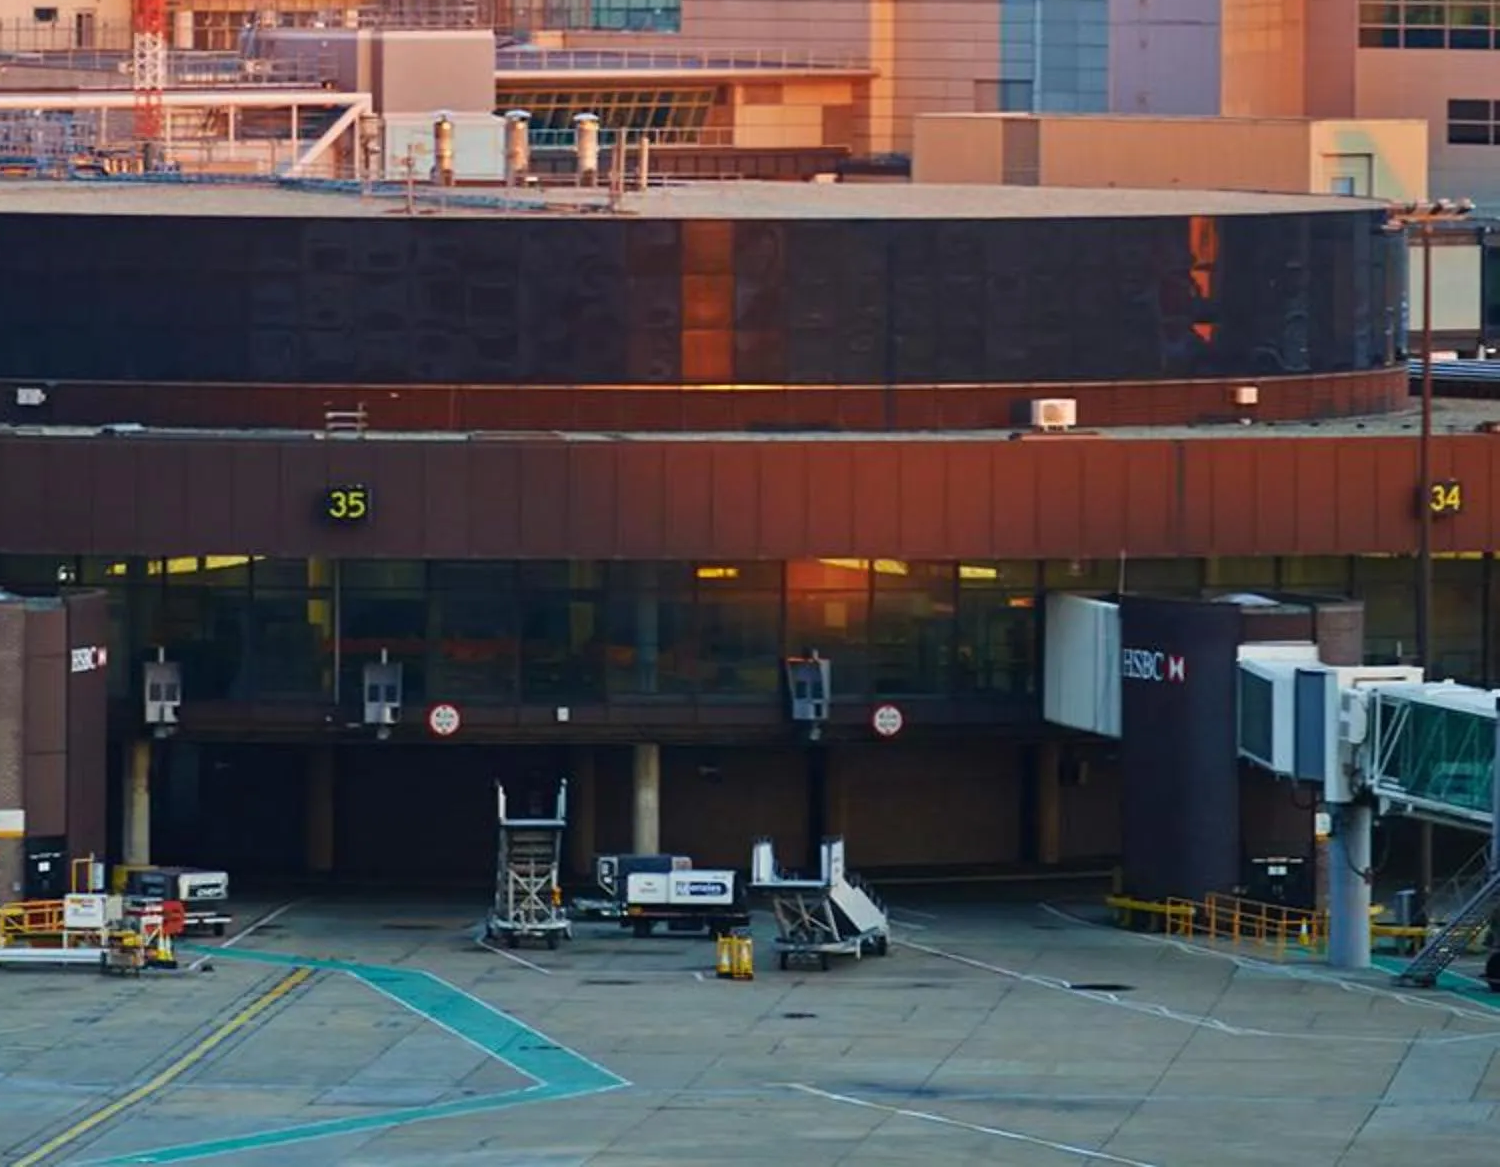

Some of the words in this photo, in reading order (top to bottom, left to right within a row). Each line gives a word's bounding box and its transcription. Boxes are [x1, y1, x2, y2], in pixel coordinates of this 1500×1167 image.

[329, 491, 366, 518] 35
[1430, 485, 1460, 511] 34
[1123, 648, 1165, 682] HSBC
